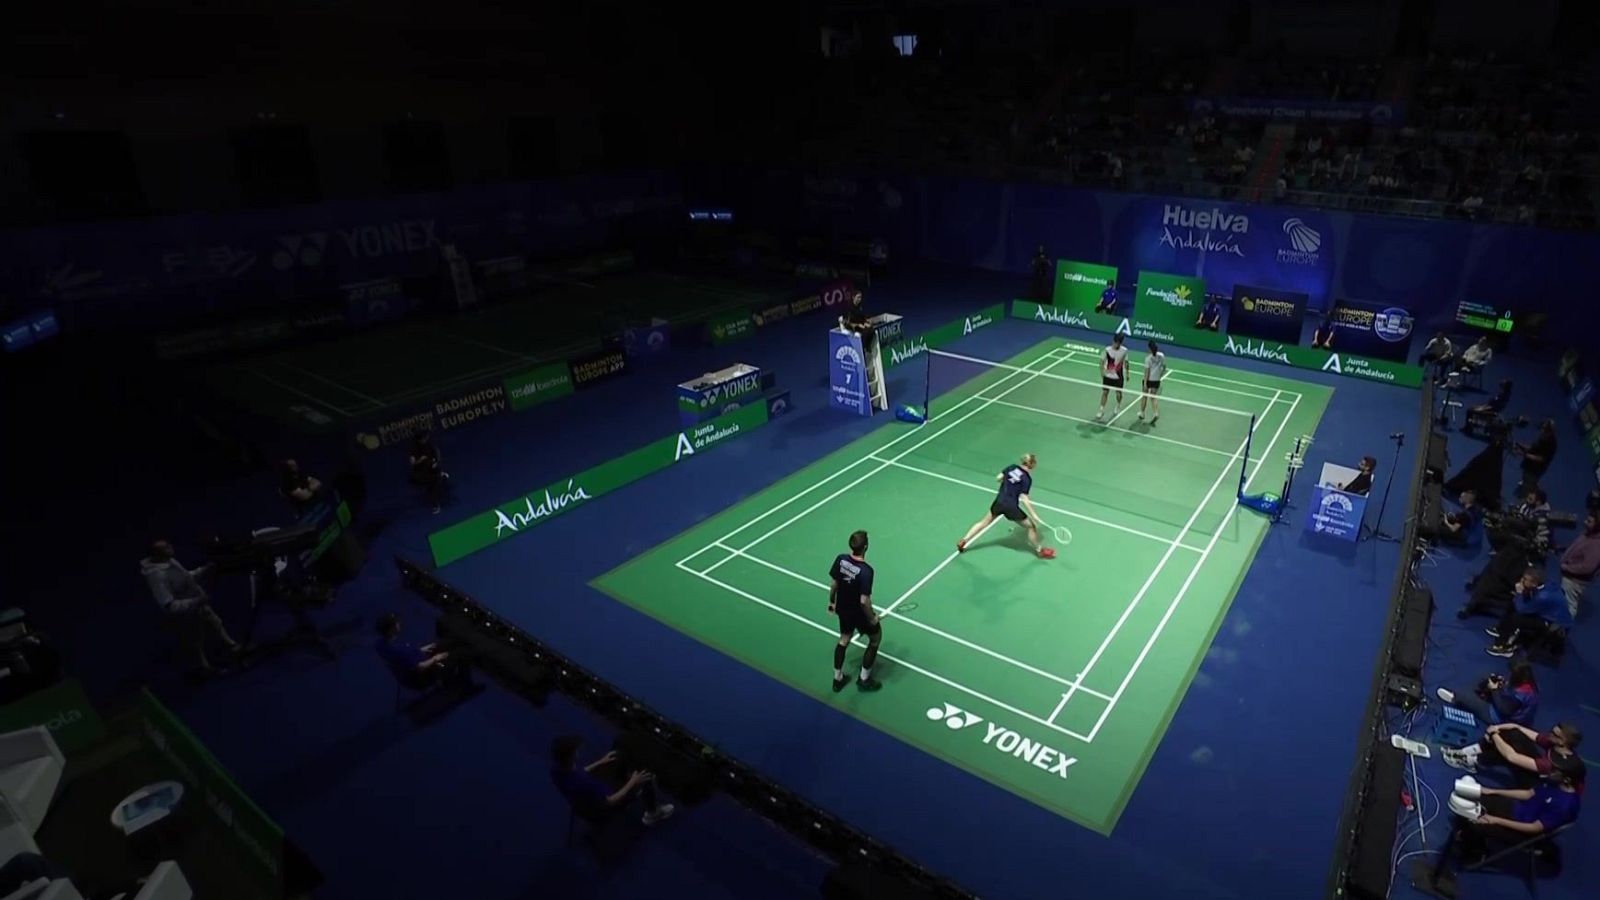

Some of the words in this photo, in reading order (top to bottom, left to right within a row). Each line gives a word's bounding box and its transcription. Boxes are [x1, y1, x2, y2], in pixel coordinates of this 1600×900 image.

[1163, 204, 1249, 233] Huelva
[1160, 227, 1244, 257] Andalucía
[1034, 304, 1090, 329] Andalucía
[1254, 305, 1294, 317] EUROPE
[1255, 298, 1295, 310] BADMINTON
[1223, 335, 1291, 365] Andalucía
[1346, 357, 1368, 367] Junta
[723, 374, 758, 399] YONEX
[436, 386, 504, 415] BADMINTON
[440, 399, 505, 429] EUROPE.TV
[694, 424, 715, 438] Junta
[695, 439, 705, 449] de
[705, 423, 740, 445] Andalucía
[495, 478, 592, 538] Andalucía
[982, 722, 1078, 779] YONEX
